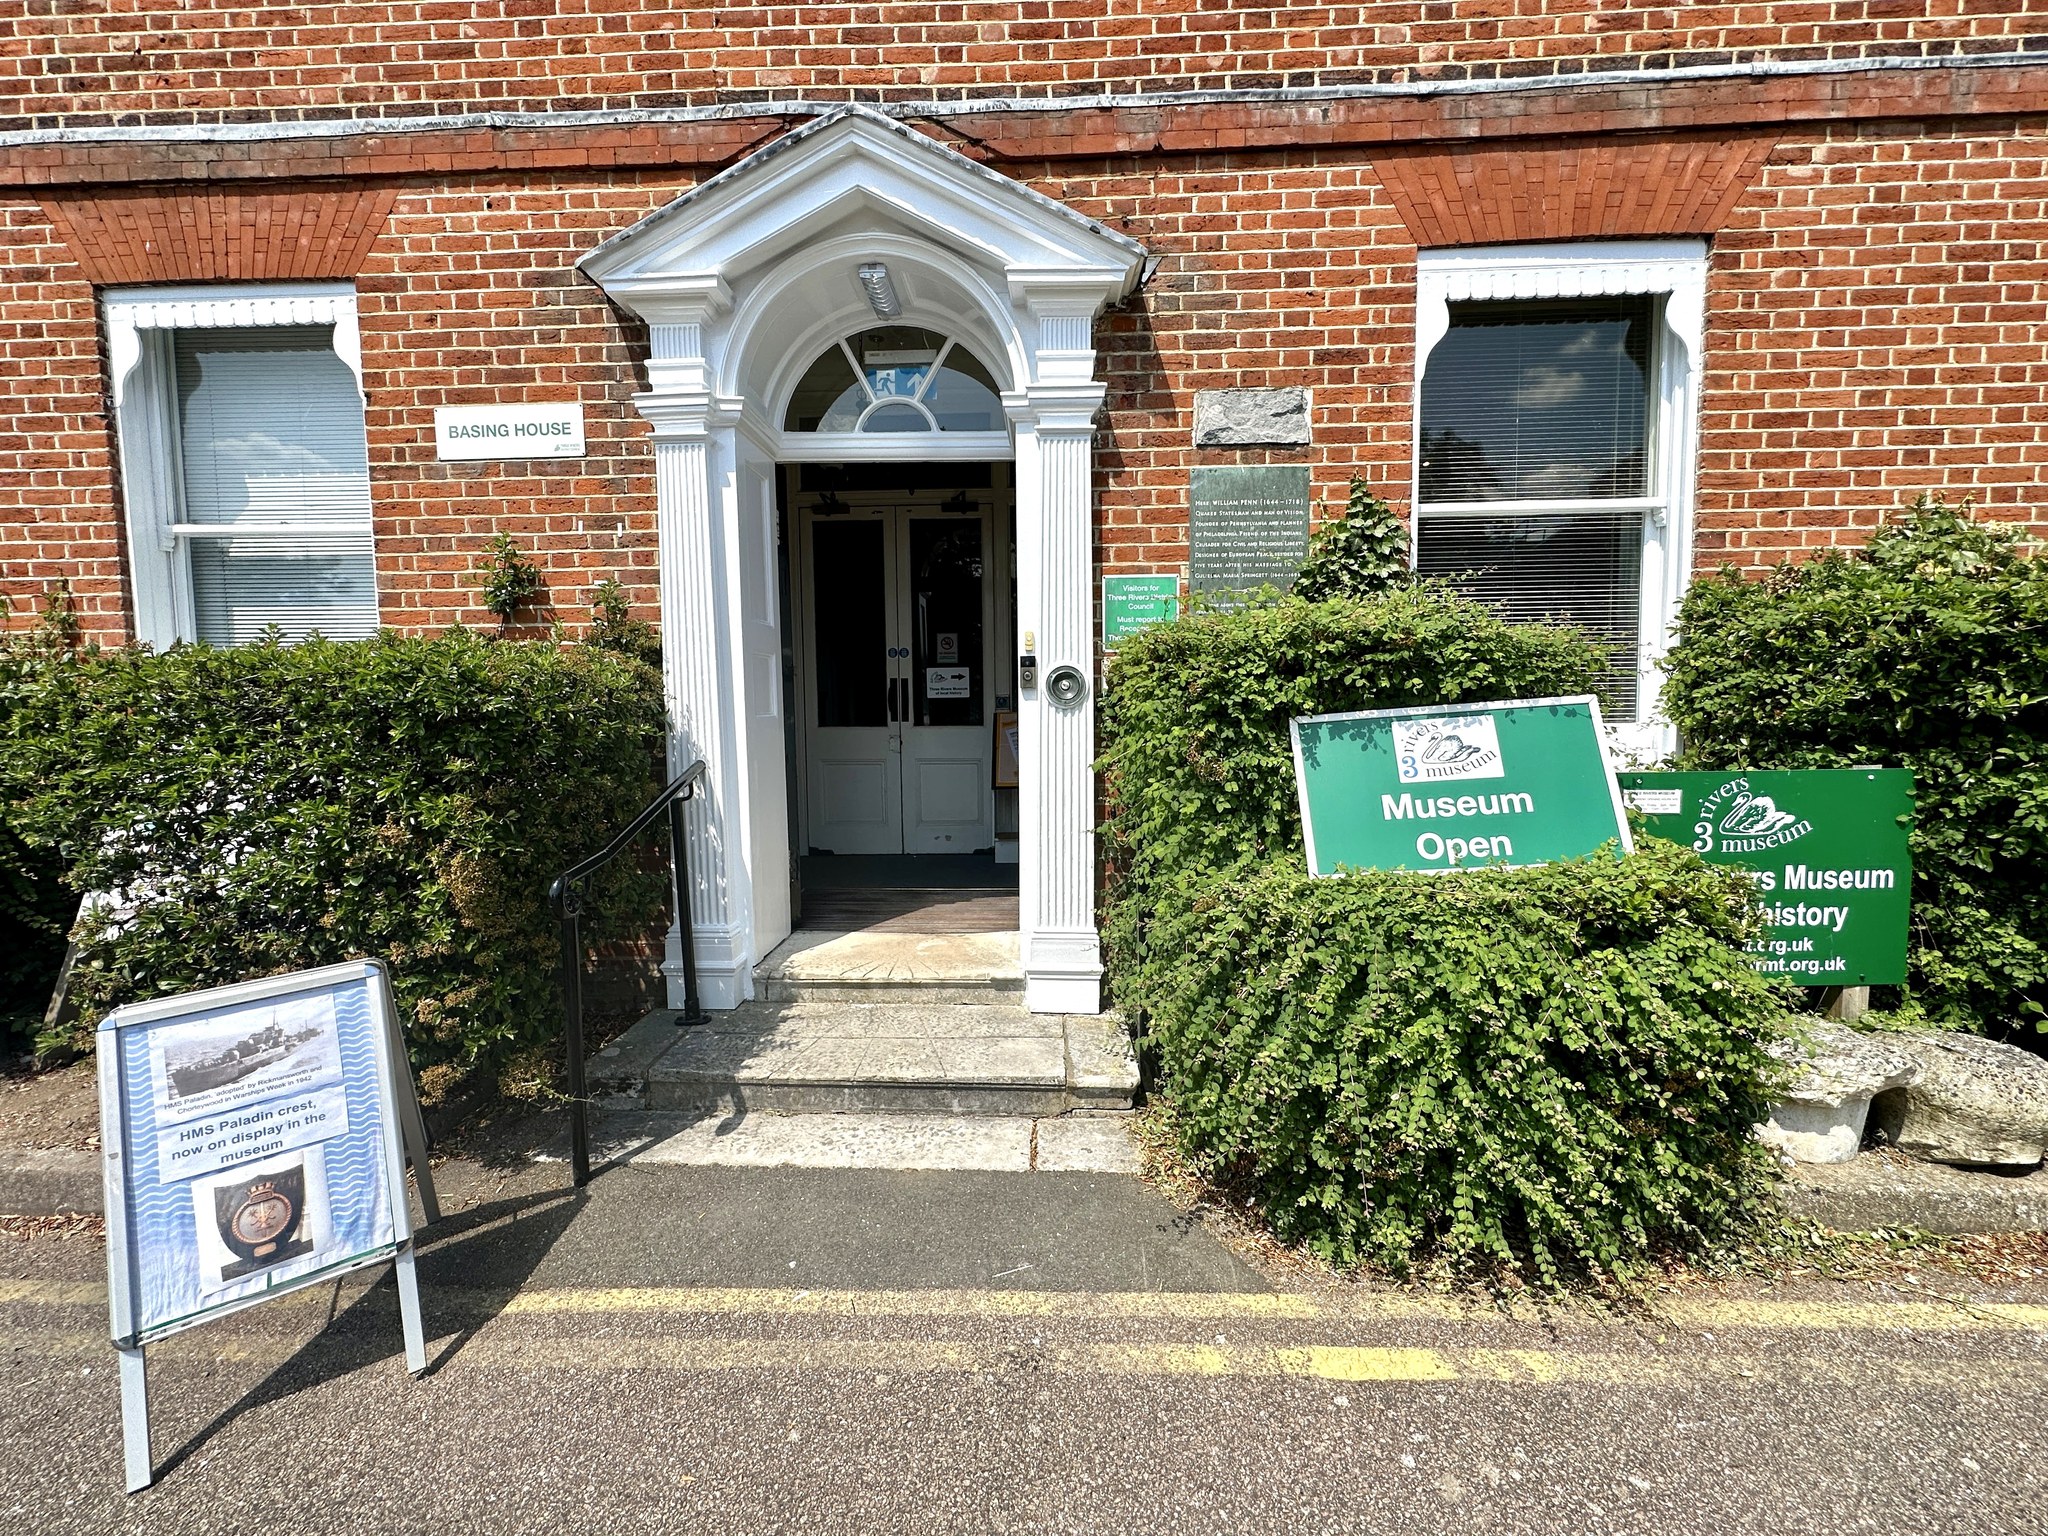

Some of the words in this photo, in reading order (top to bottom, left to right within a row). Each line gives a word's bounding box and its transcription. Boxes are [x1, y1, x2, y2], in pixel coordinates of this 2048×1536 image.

[449, 424, 509, 439] BASING
[514, 422, 572, 436] HOUSE
[1136, 616, 1157, 624] report
[1401, 721, 1439, 753] rivers
[1402, 756, 1418, 778] 3
[1426, 750, 1497, 777] museum
[1381, 792, 1534, 821] Museum
[1699, 777, 1749, 819] rivers
[1416, 832, 1513, 865] Open
[1693, 822, 1713, 853] 3
[1721, 819, 1813, 853] museum
[1784, 864, 1894, 890] Museum
[164, 1100, 182, 1110] HMS
[257, 1069, 309, 1085] Rickmansworth
[310, 1065, 322, 1073] and
[177, 1098, 224, 1114] Chorleywood
[232, 1087, 265, 1100] Warships
[266, 1082, 287, 1091] Week
[180, 1124, 215, 1142] HMS
[219, 1110, 274, 1132] Paladin
[278, 1099, 317, 1117] crest,
[172, 1145, 203, 1161] now
[207, 1138, 227, 1151] on
[231, 1123, 284, 1144] display
[287, 1119, 300, 1130] in
[304, 1112, 327, 1126] the
[220, 1140, 284, 1164] museum
